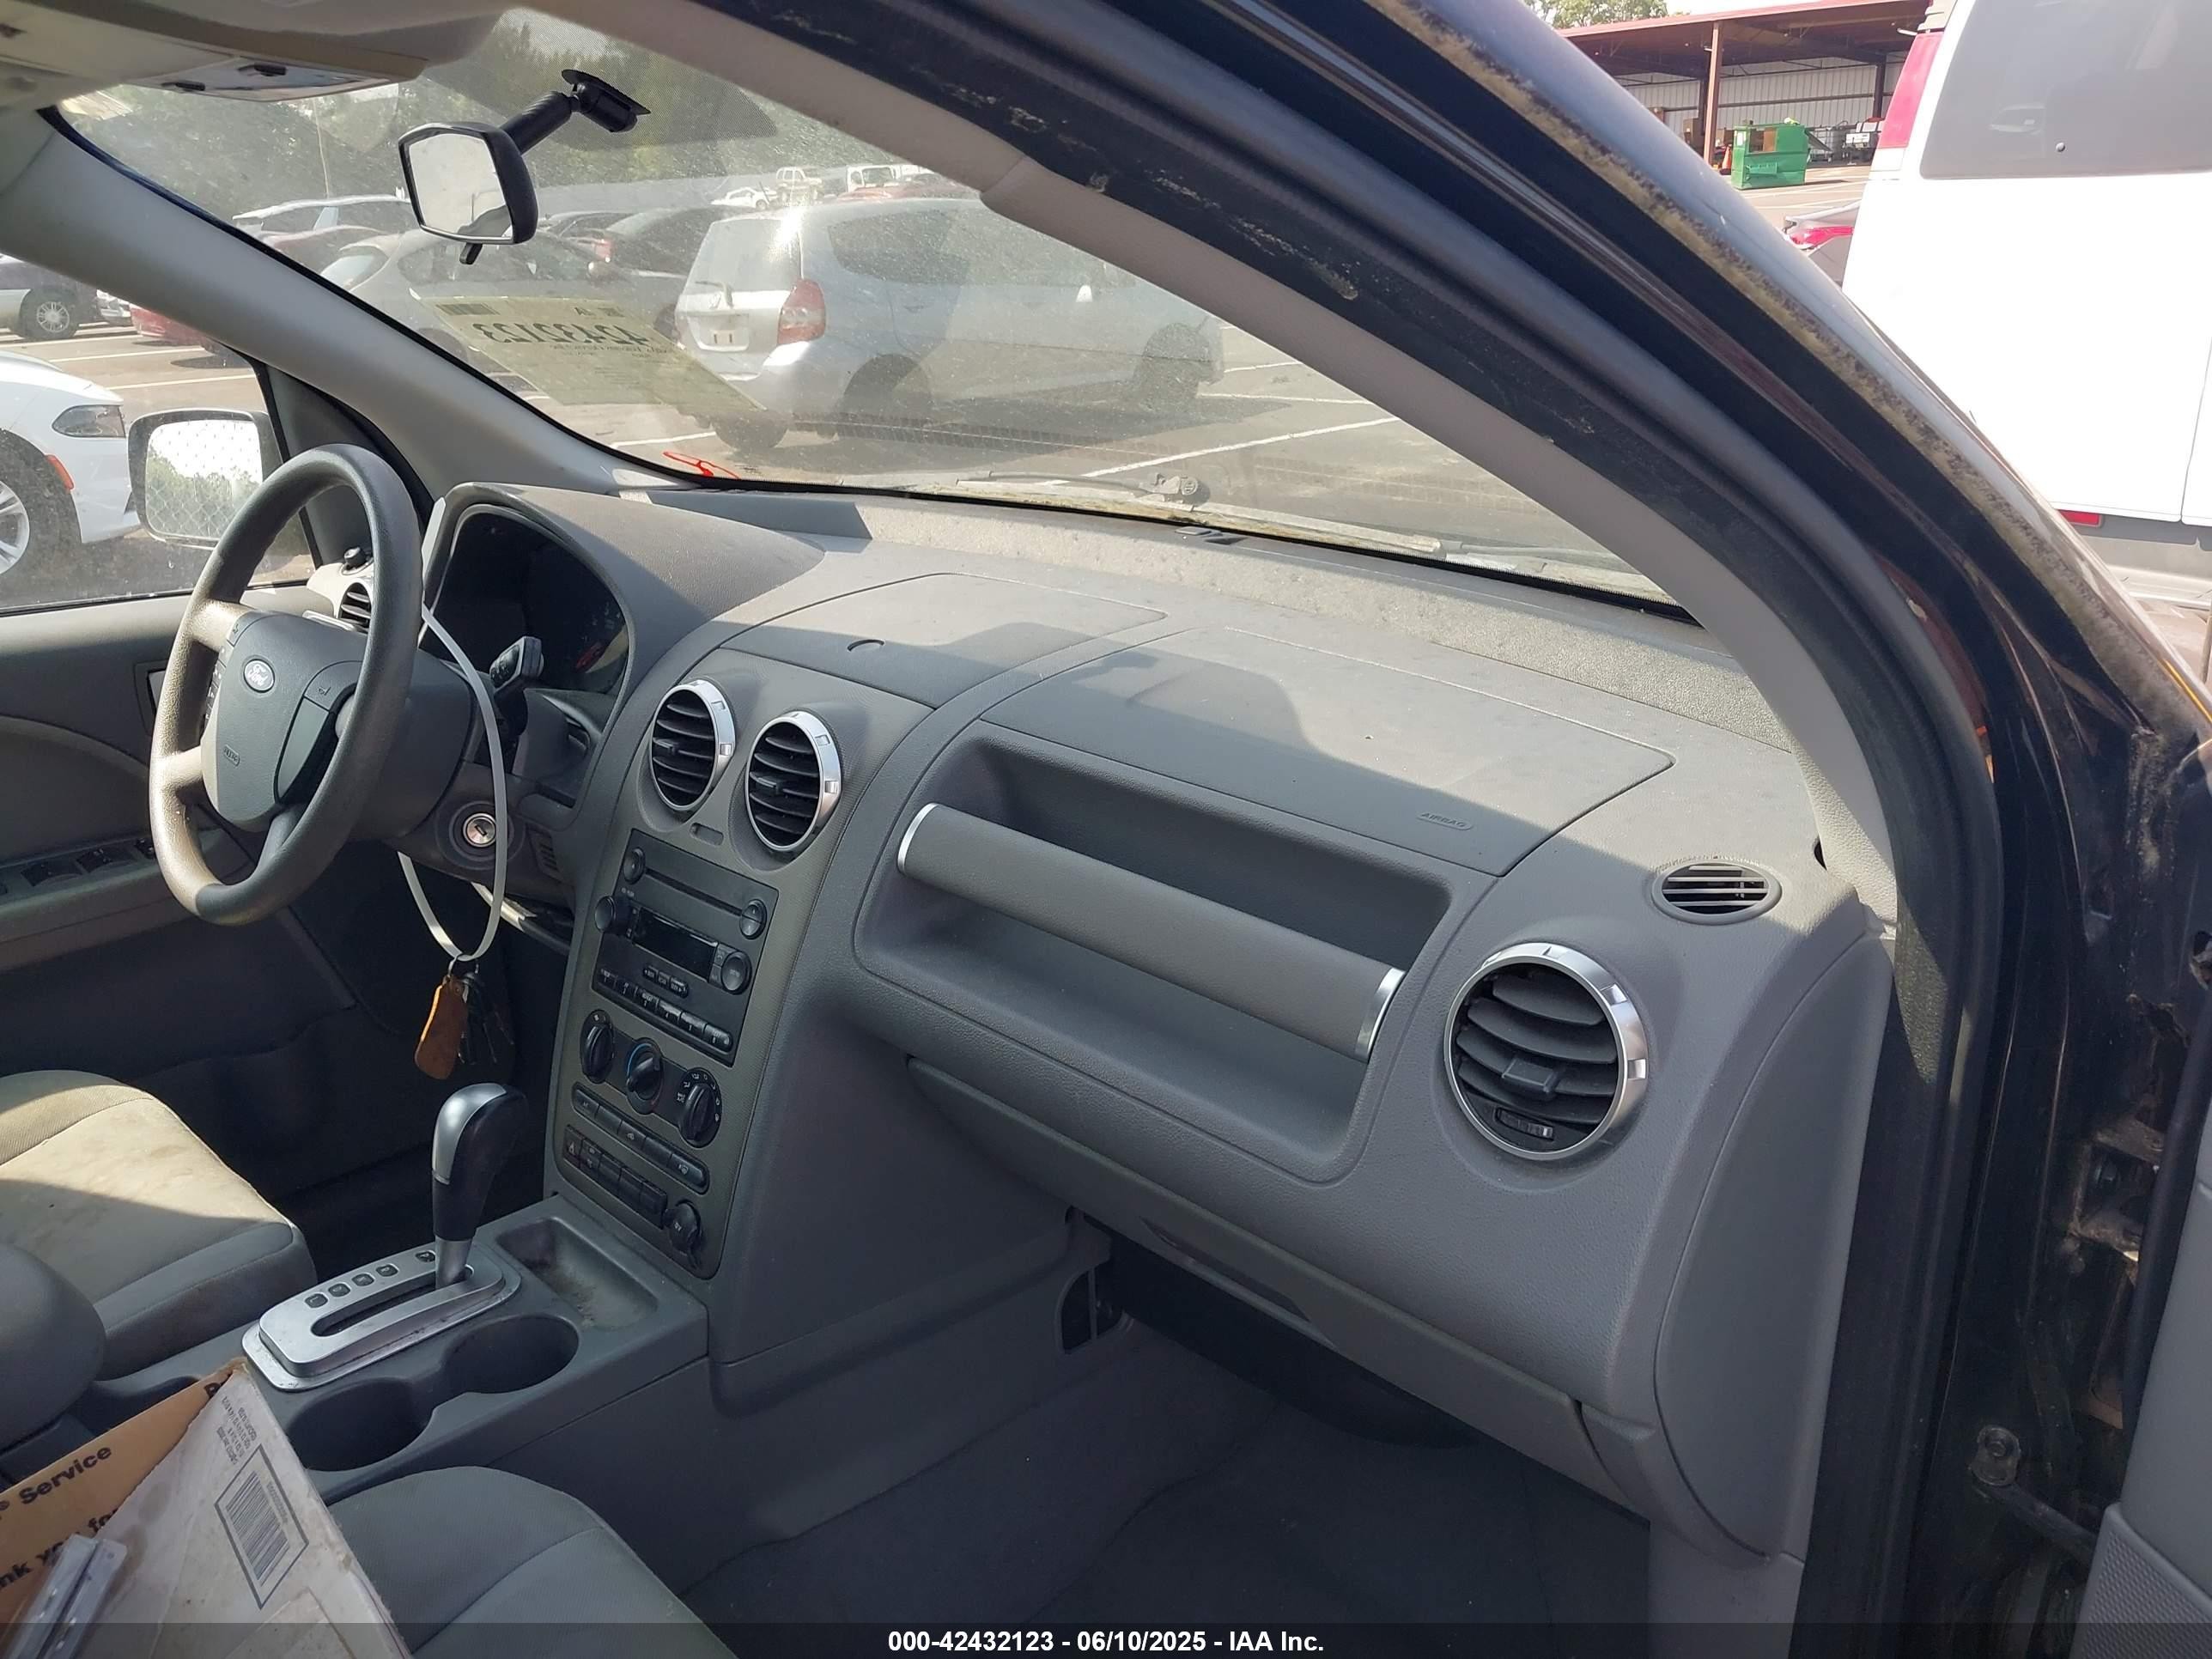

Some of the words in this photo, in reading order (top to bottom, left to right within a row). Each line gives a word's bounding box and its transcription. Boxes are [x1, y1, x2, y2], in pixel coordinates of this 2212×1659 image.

[1421, 812, 1467, 828] AIRBAG
[19, 1447, 112, 1504] Service
[88, 1507, 118, 1534] fo
